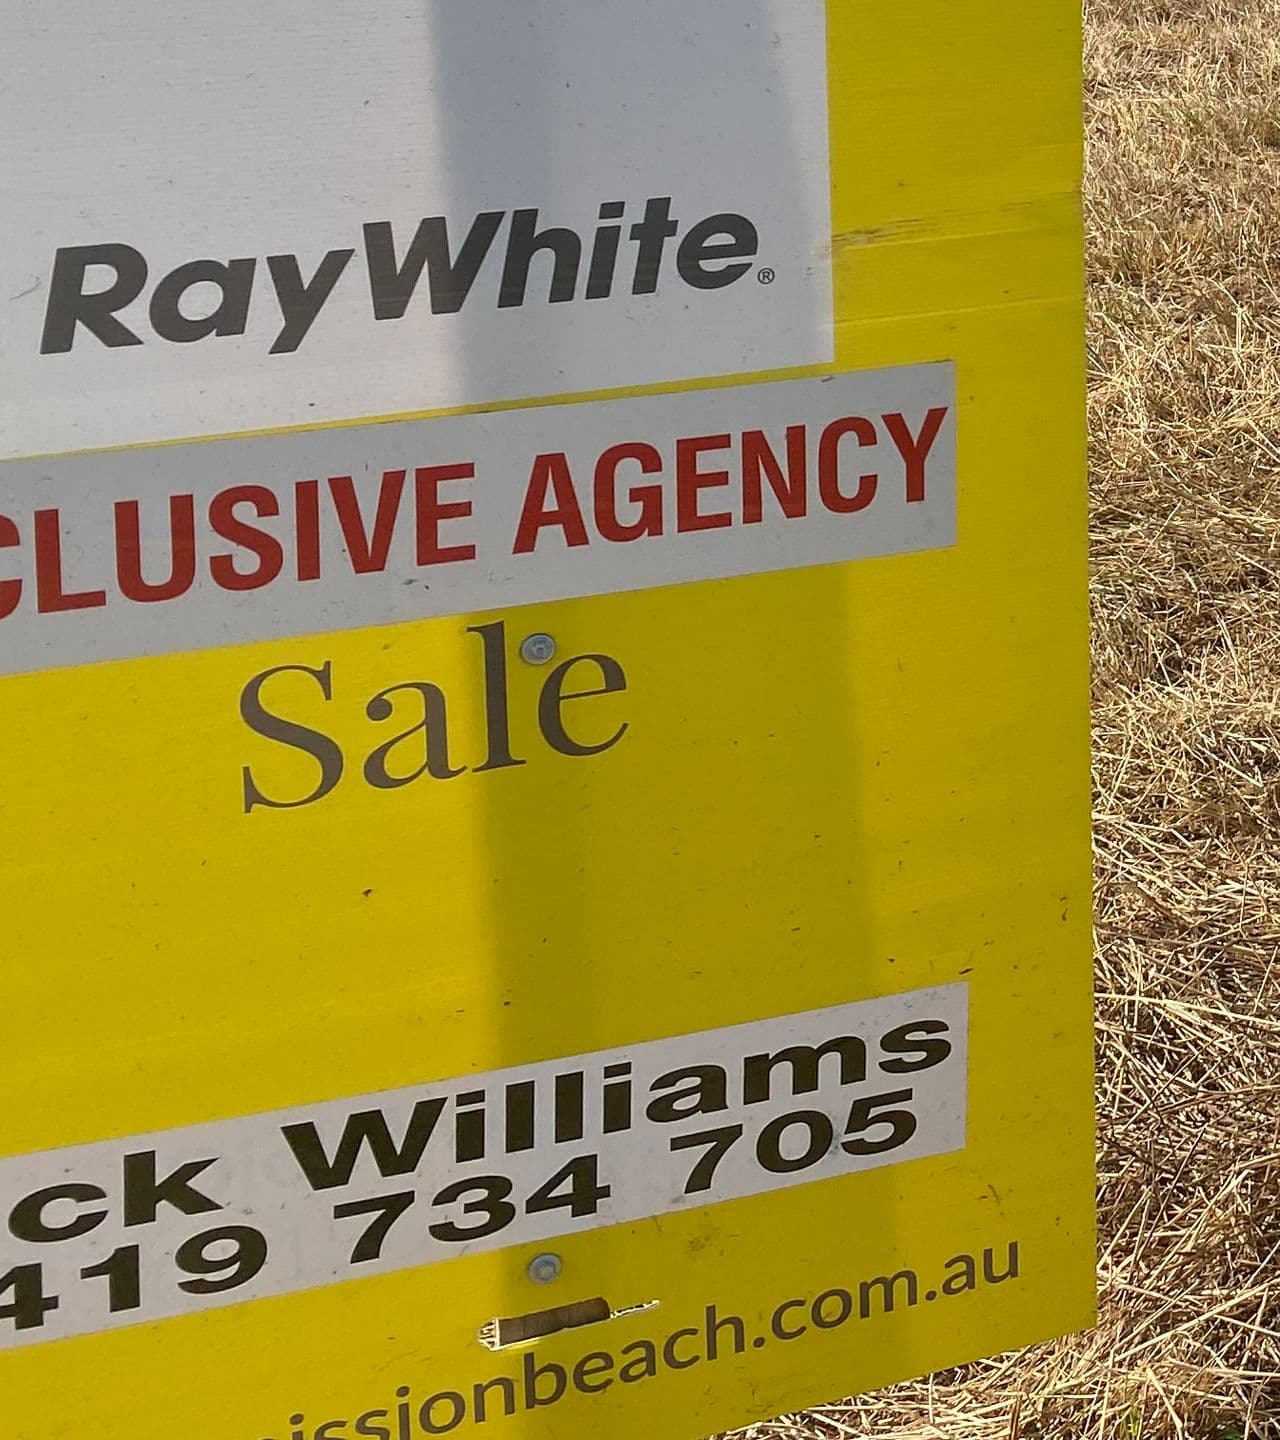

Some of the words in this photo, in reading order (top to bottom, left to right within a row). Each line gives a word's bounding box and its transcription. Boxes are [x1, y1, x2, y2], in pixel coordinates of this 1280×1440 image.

[0, 462, 478, 621] LUSIVE
[512, 406, 949, 555] AGENCY
[238, 618, 630, 815] Sale
[279, 1018, 953, 1192] Williams
[332, 1152, 613, 1266] 734
[668, 1086, 918, 1196] 705
[260, 1240, 1020, 1440] sionbeach.com.au
